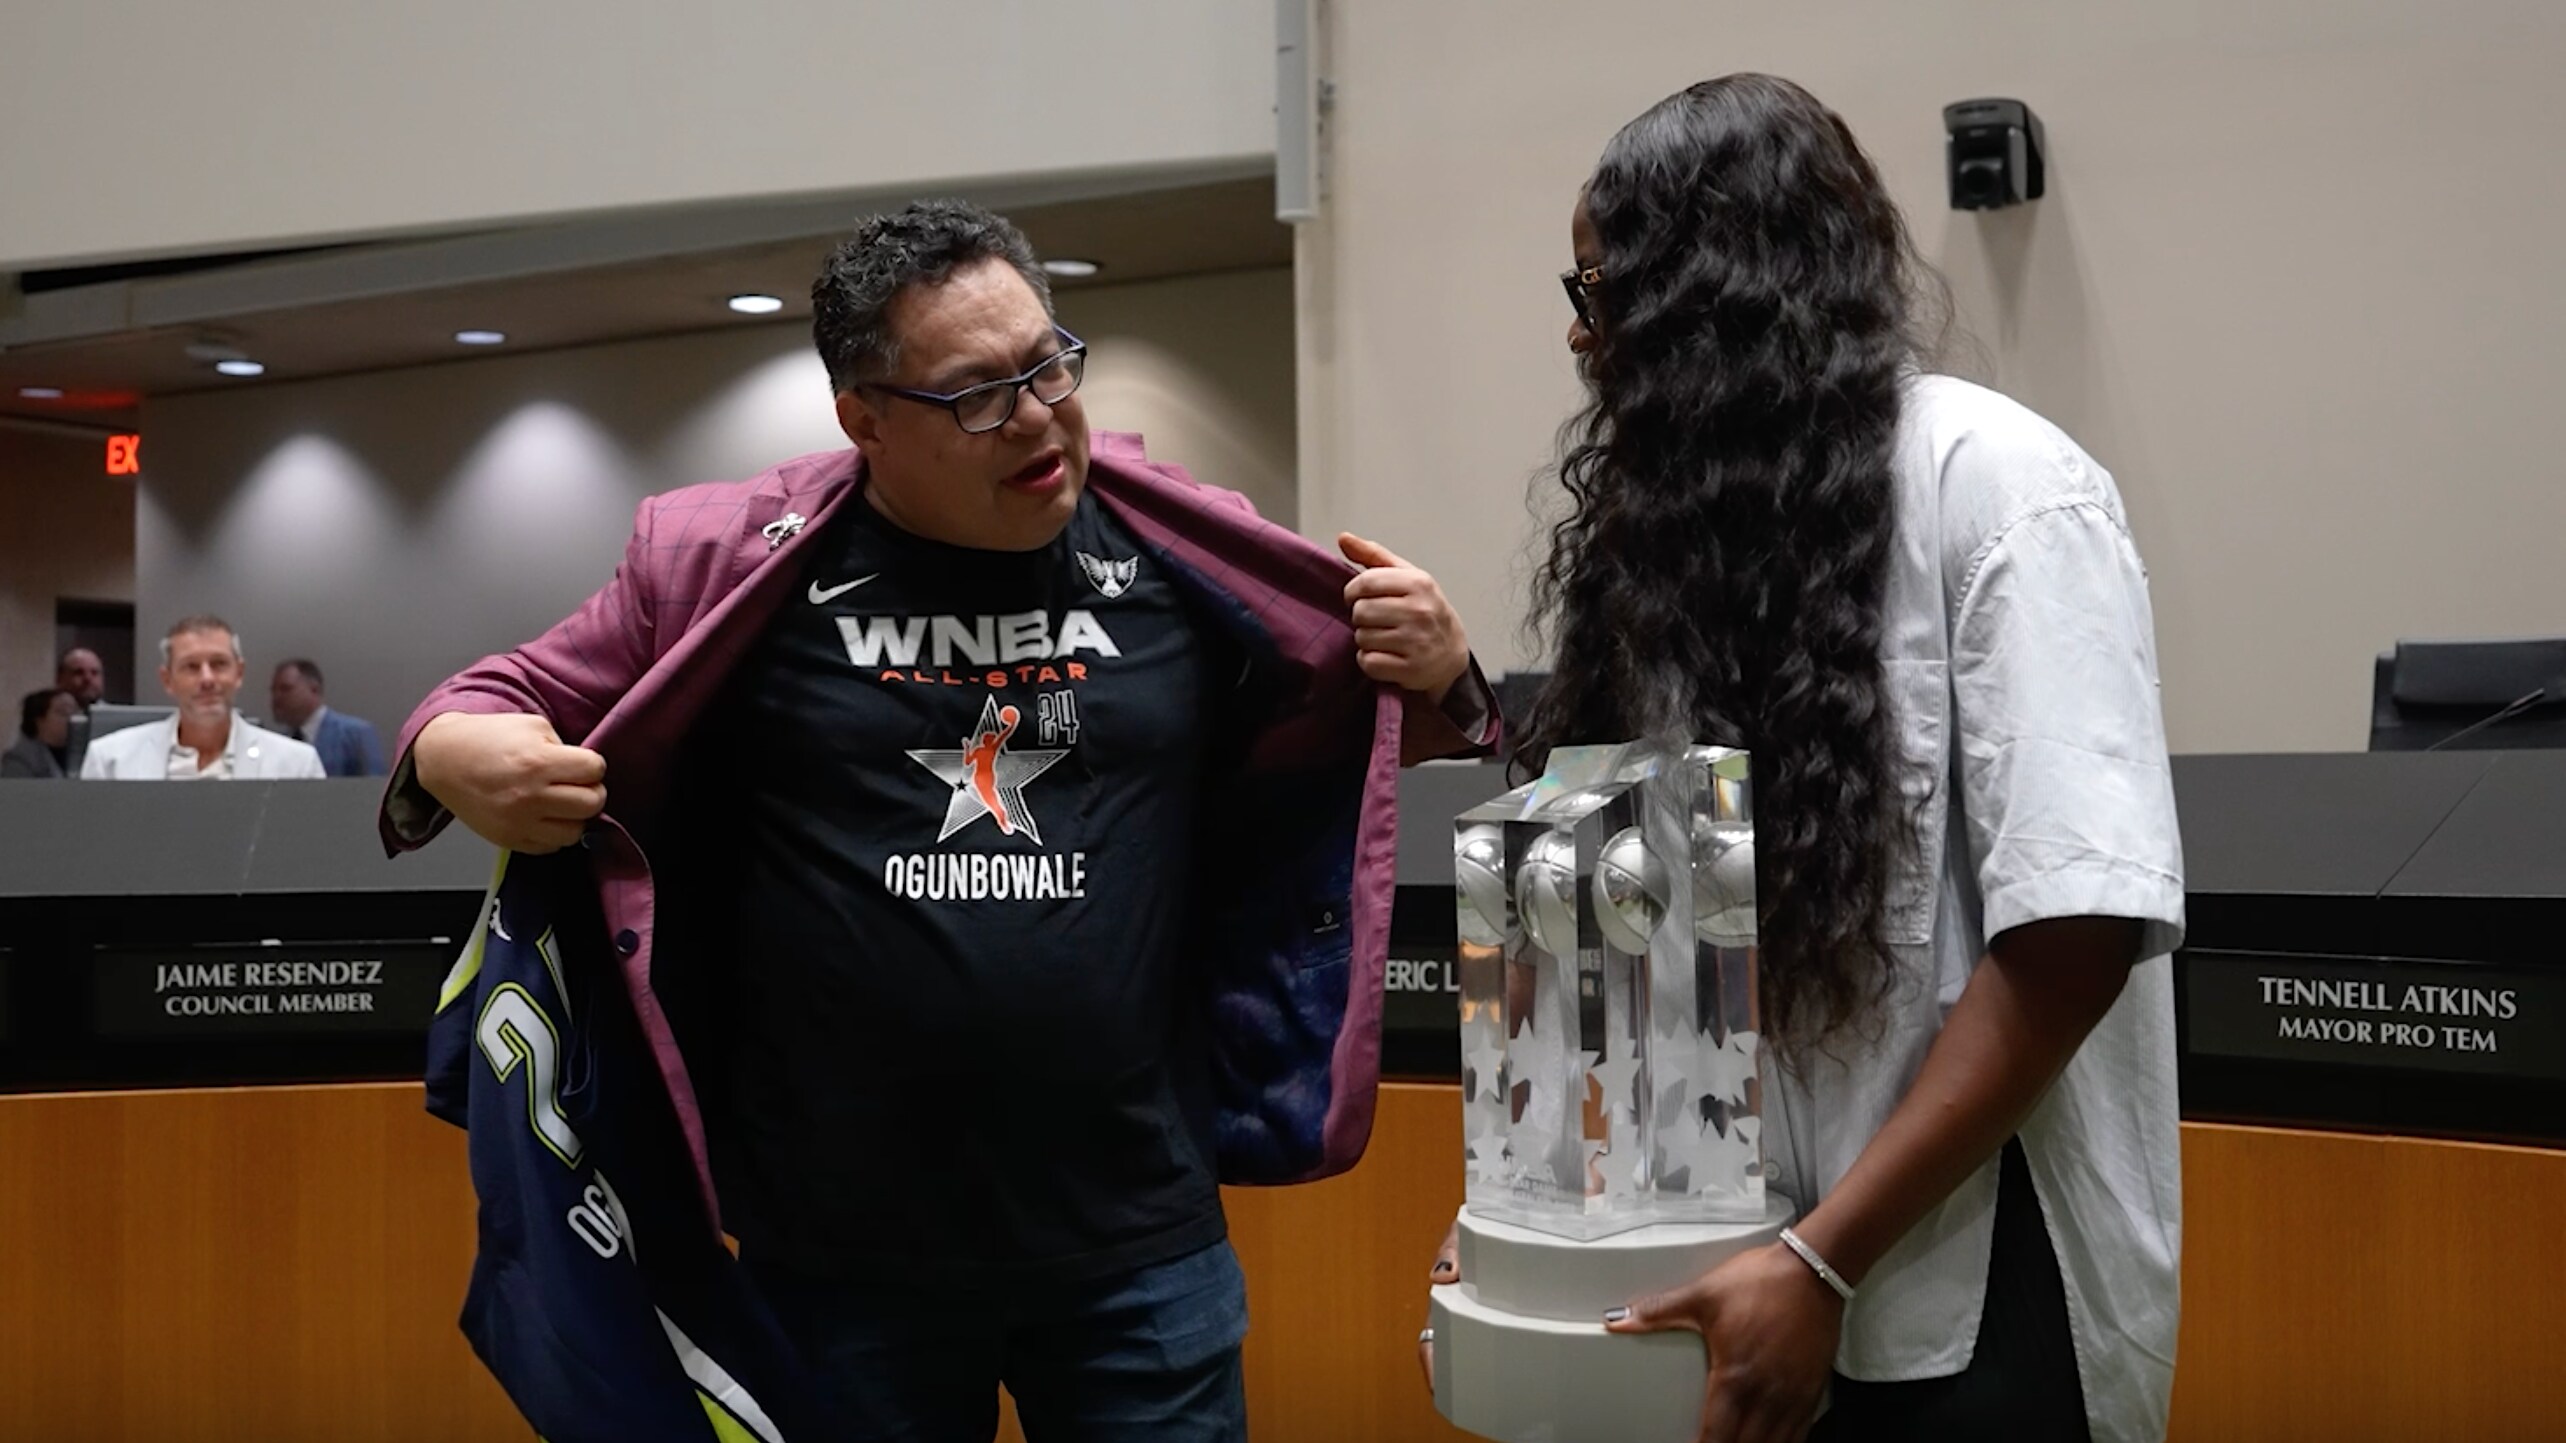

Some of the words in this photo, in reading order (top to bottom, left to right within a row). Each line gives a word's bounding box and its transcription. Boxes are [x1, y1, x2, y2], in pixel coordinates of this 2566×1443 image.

[834, 609, 1122, 667] WNBA
[879, 662, 1088, 688] ALL-STAR
[1037, 689, 1080, 746] 24
[884, 852, 1087, 901] OGUNBOWALE
[155, 963, 237, 993] JAIME
[244, 960, 383, 986] RESENDEZ
[1384, 958, 1439, 991] ERIC
[165, 994, 274, 1016] COUNCIL
[278, 992, 374, 1014] MEMBER
[2257, 976, 2393, 1011] TENNELL
[2400, 985, 2517, 1020] ATKINS
[476, 925, 584, 1170] 2
[2278, 1016, 2373, 1044] MAYOR
[2380, 1022, 2436, 1048] PRO
[2441, 1026, 2498, 1053] TEM
